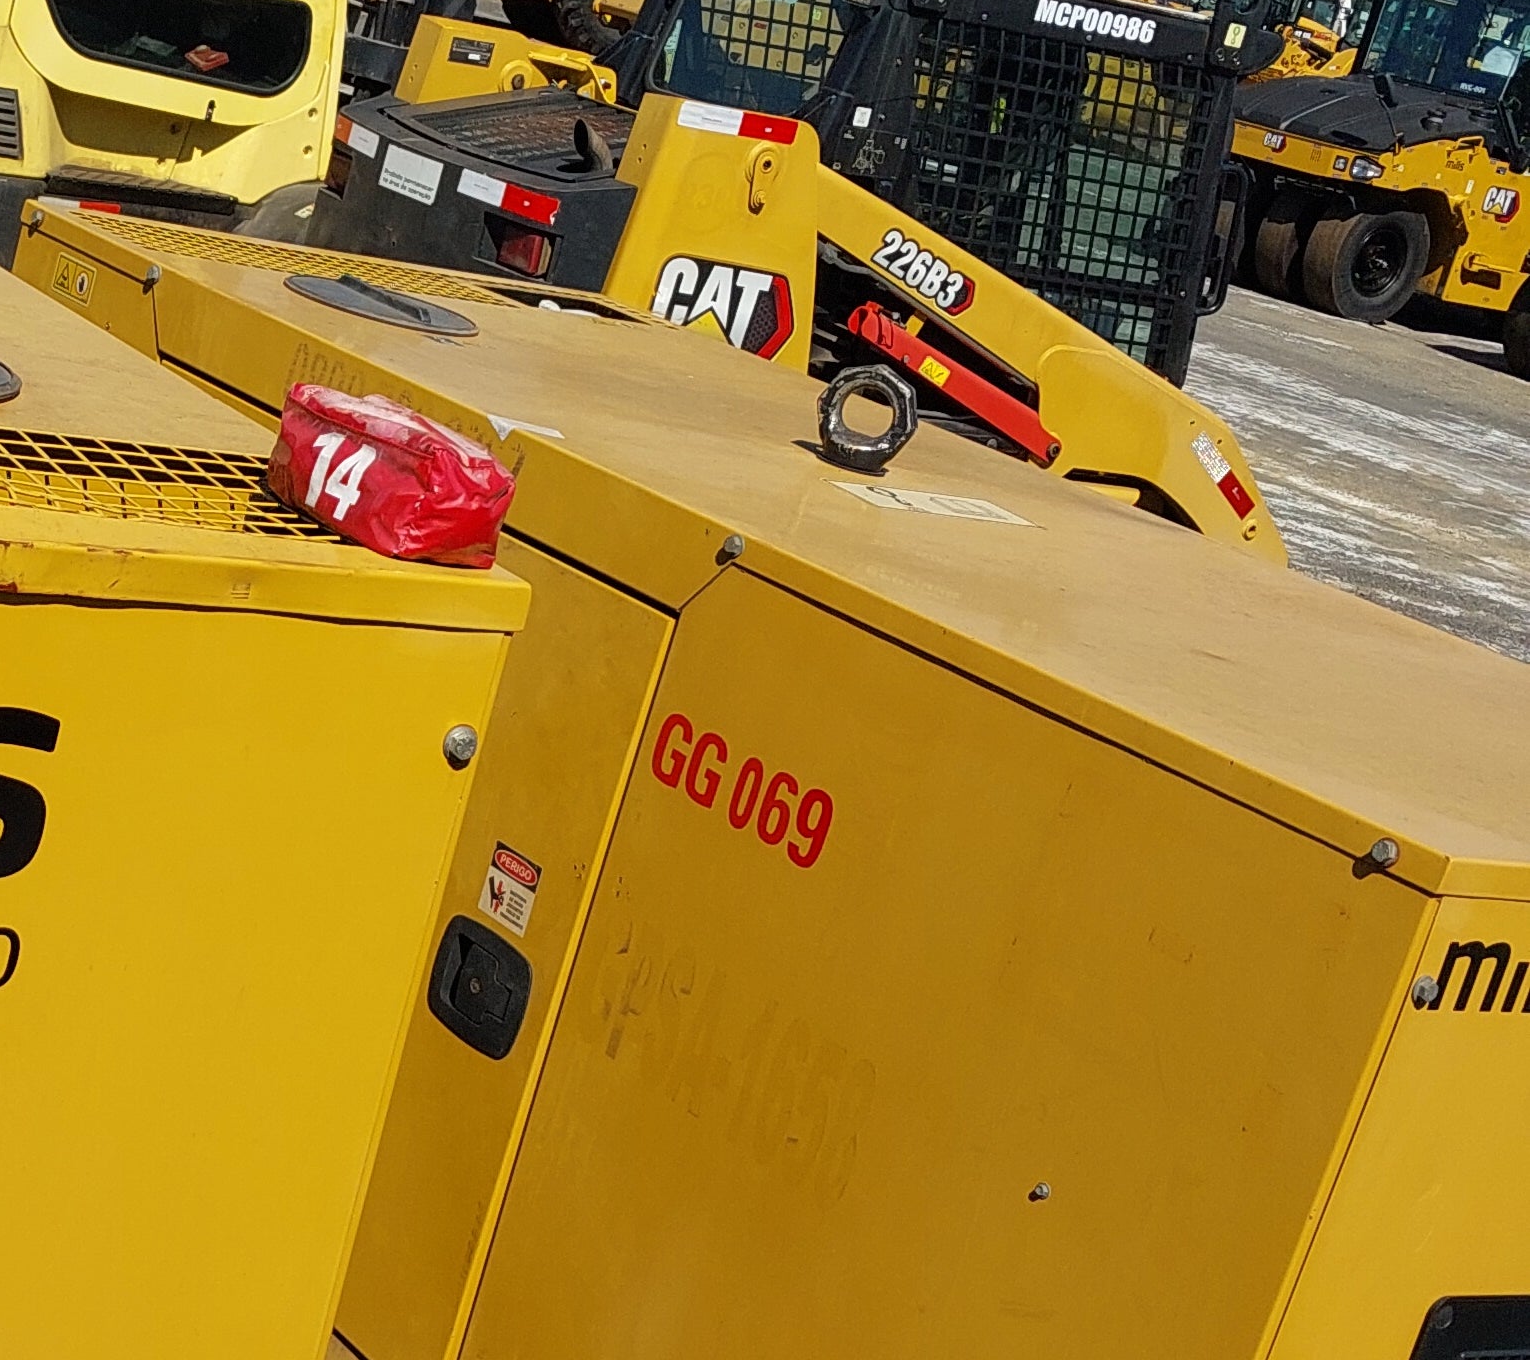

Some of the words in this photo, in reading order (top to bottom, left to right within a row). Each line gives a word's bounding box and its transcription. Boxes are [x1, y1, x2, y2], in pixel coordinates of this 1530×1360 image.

[1263, 132, 1285, 150] CAT
[1482, 186, 1518, 216] CAT
[651, 256, 775, 350] CAT
[871, 229, 965, 309] 226B3
[304, 432, 377, 522] 14
[650, 712, 729, 810] GG
[728, 756, 835, 869] 069
[499, 853, 533, 881] PERIGO
